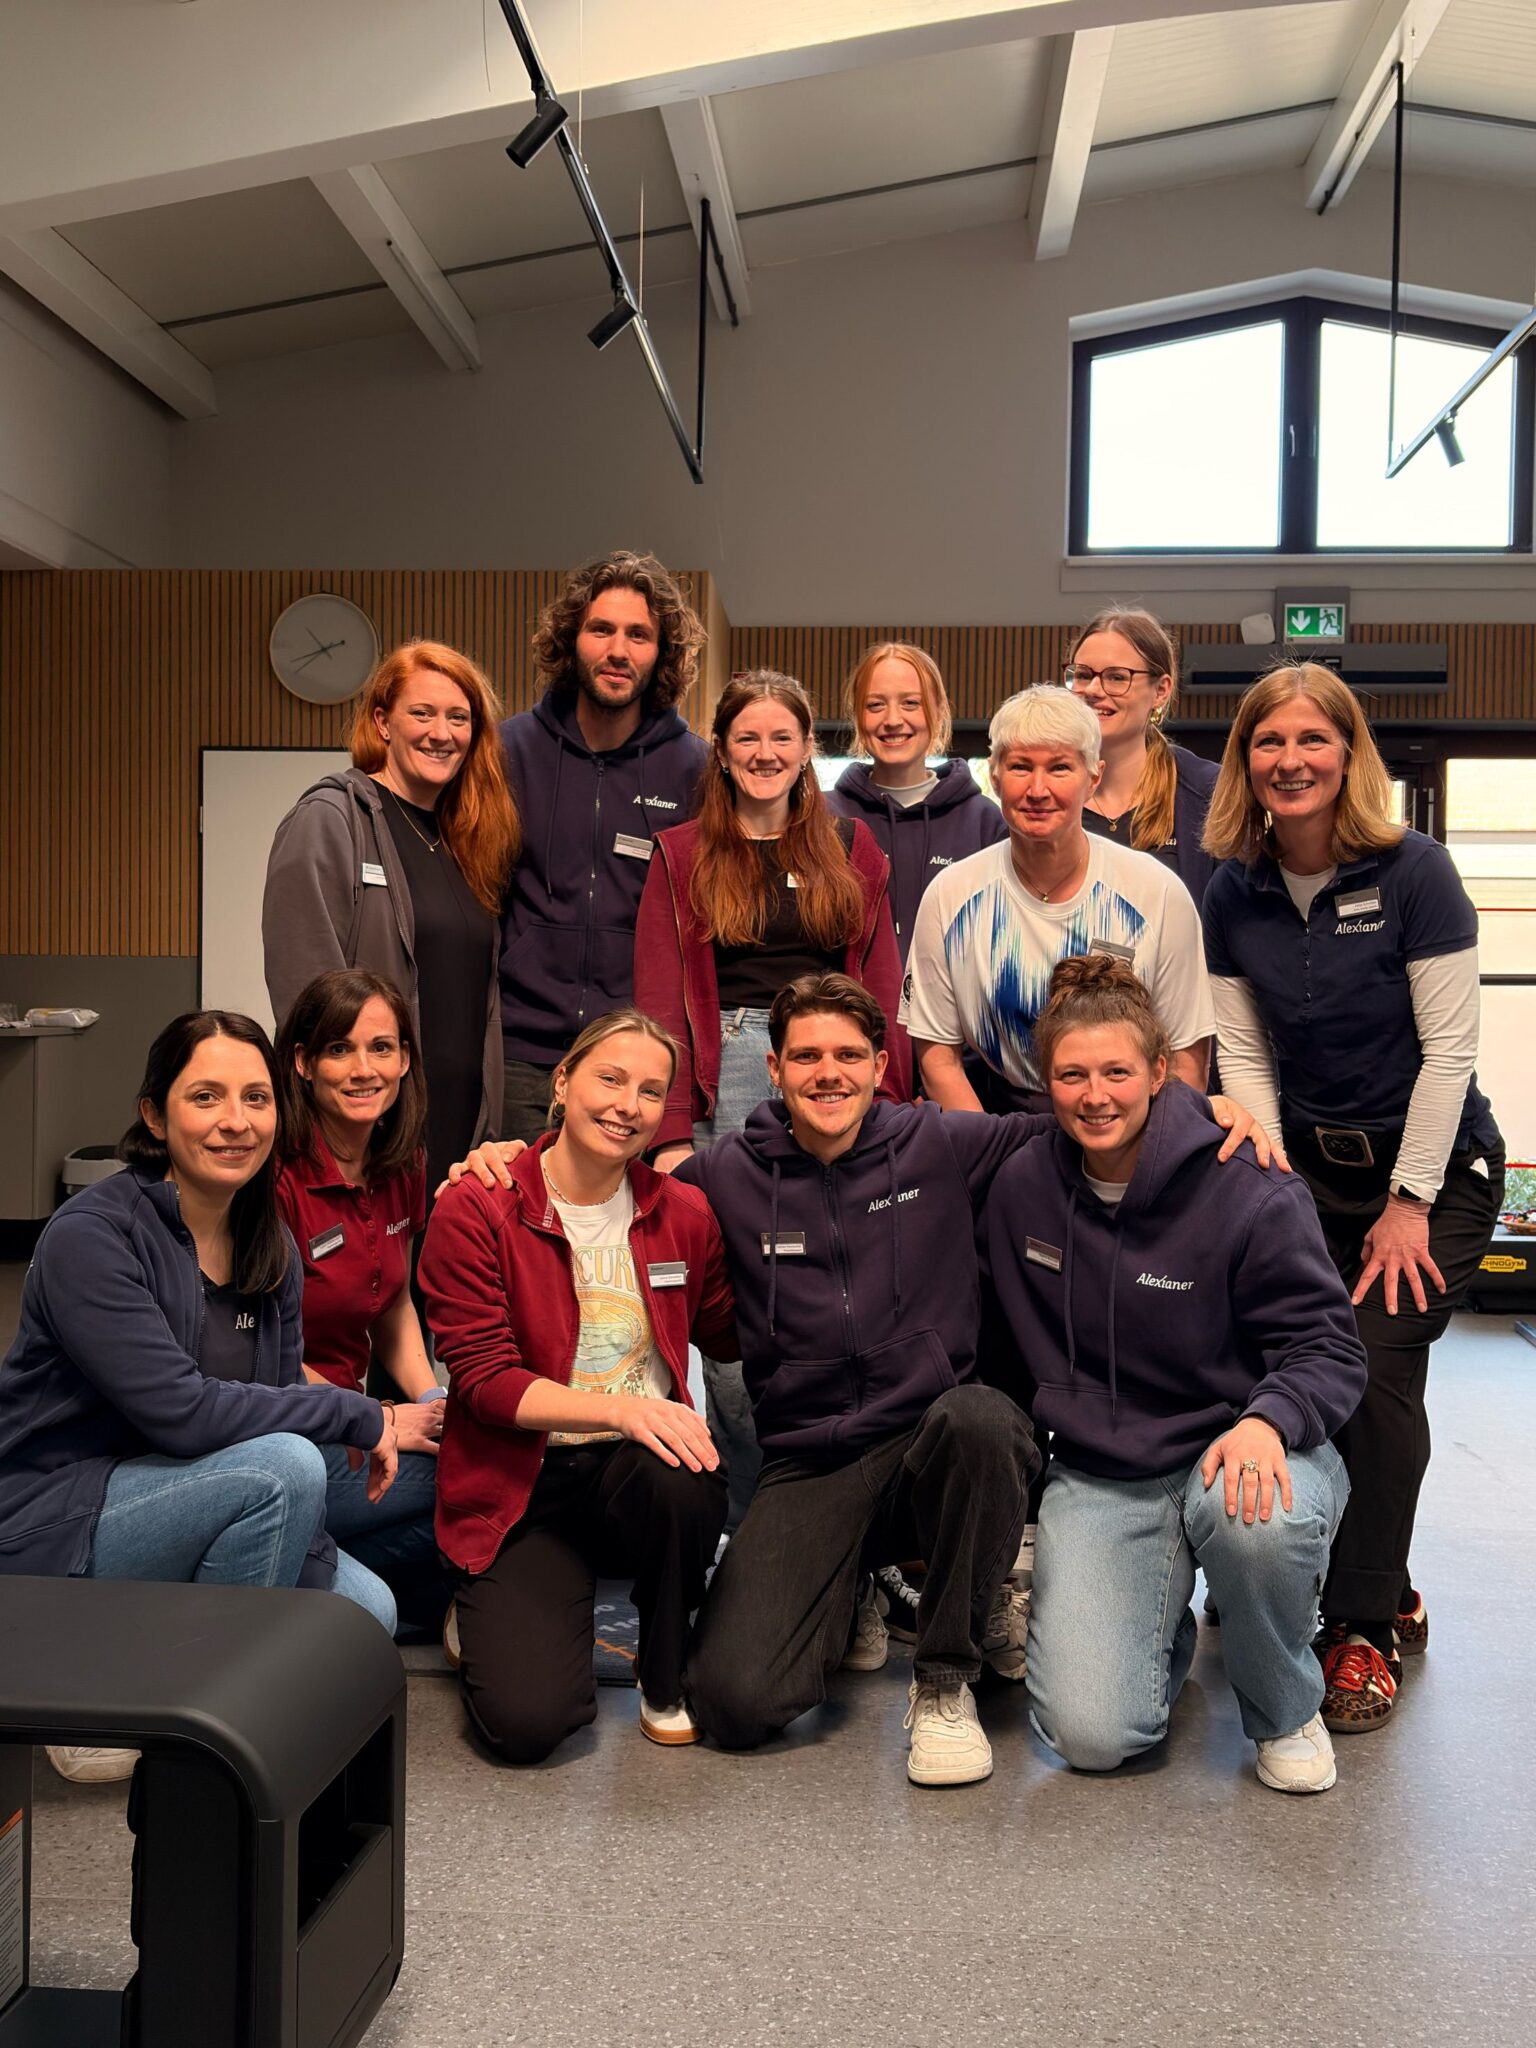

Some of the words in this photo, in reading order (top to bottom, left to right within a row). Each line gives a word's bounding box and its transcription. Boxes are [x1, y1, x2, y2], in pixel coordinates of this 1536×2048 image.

[633, 795, 678, 810] Aexianer
[868, 1188, 920, 1213] Alexner
[576, 1248, 636, 1292] CUR
[1480, 1258, 1526, 1269] CHNOGYM
[1136, 1272, 1194, 1291] Alexianer
[235, 1313, 255, 1330] Ale
